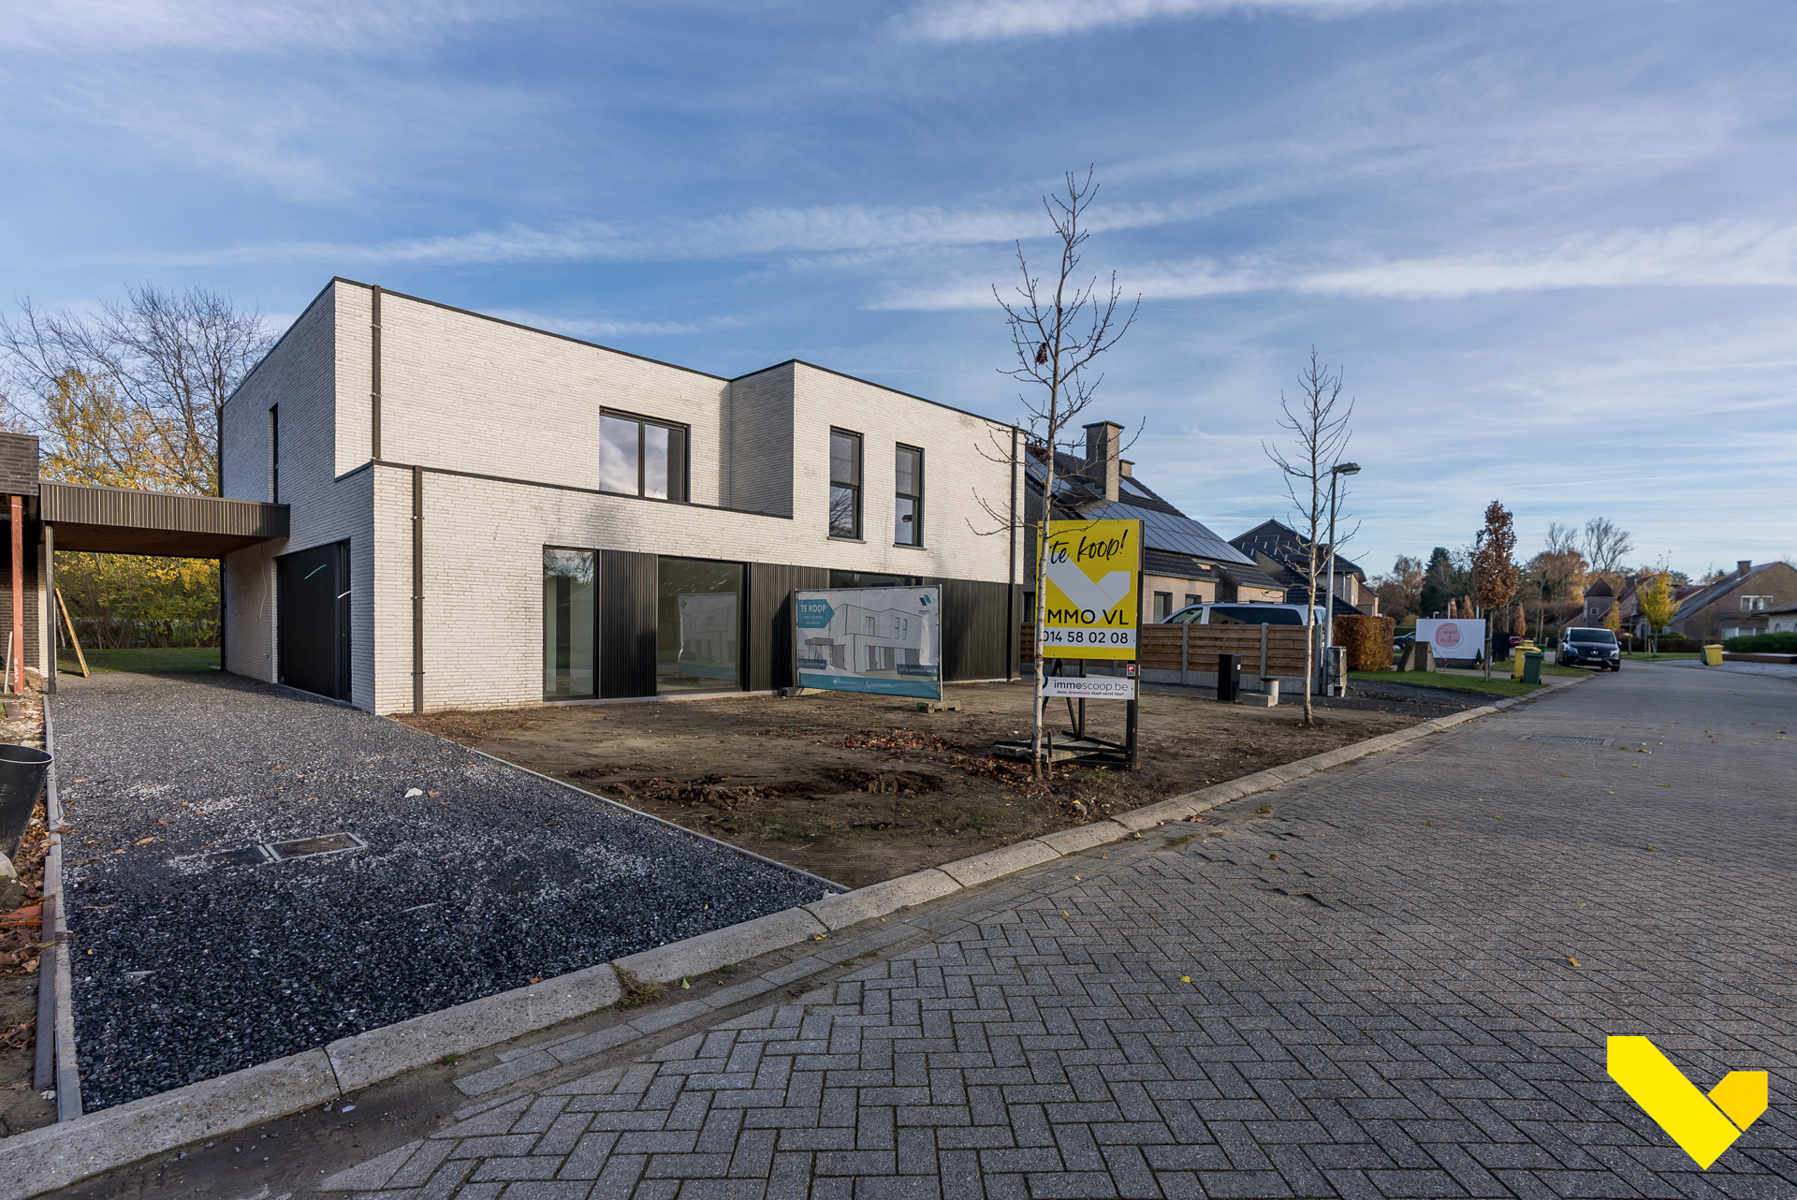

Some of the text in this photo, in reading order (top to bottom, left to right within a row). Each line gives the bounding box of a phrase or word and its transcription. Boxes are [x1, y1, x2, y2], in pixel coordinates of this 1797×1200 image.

[1049, 529, 1128, 564] te koop!
[800, 604, 827, 613] TE KOOP
[1047, 608, 1129, 626] MMO VL
[1067, 631, 1084, 643] 58
[1088, 631, 1106, 644] 02
[1110, 632, 1128, 645] 08
[1054, 680, 1128, 692] immoscoop.be
